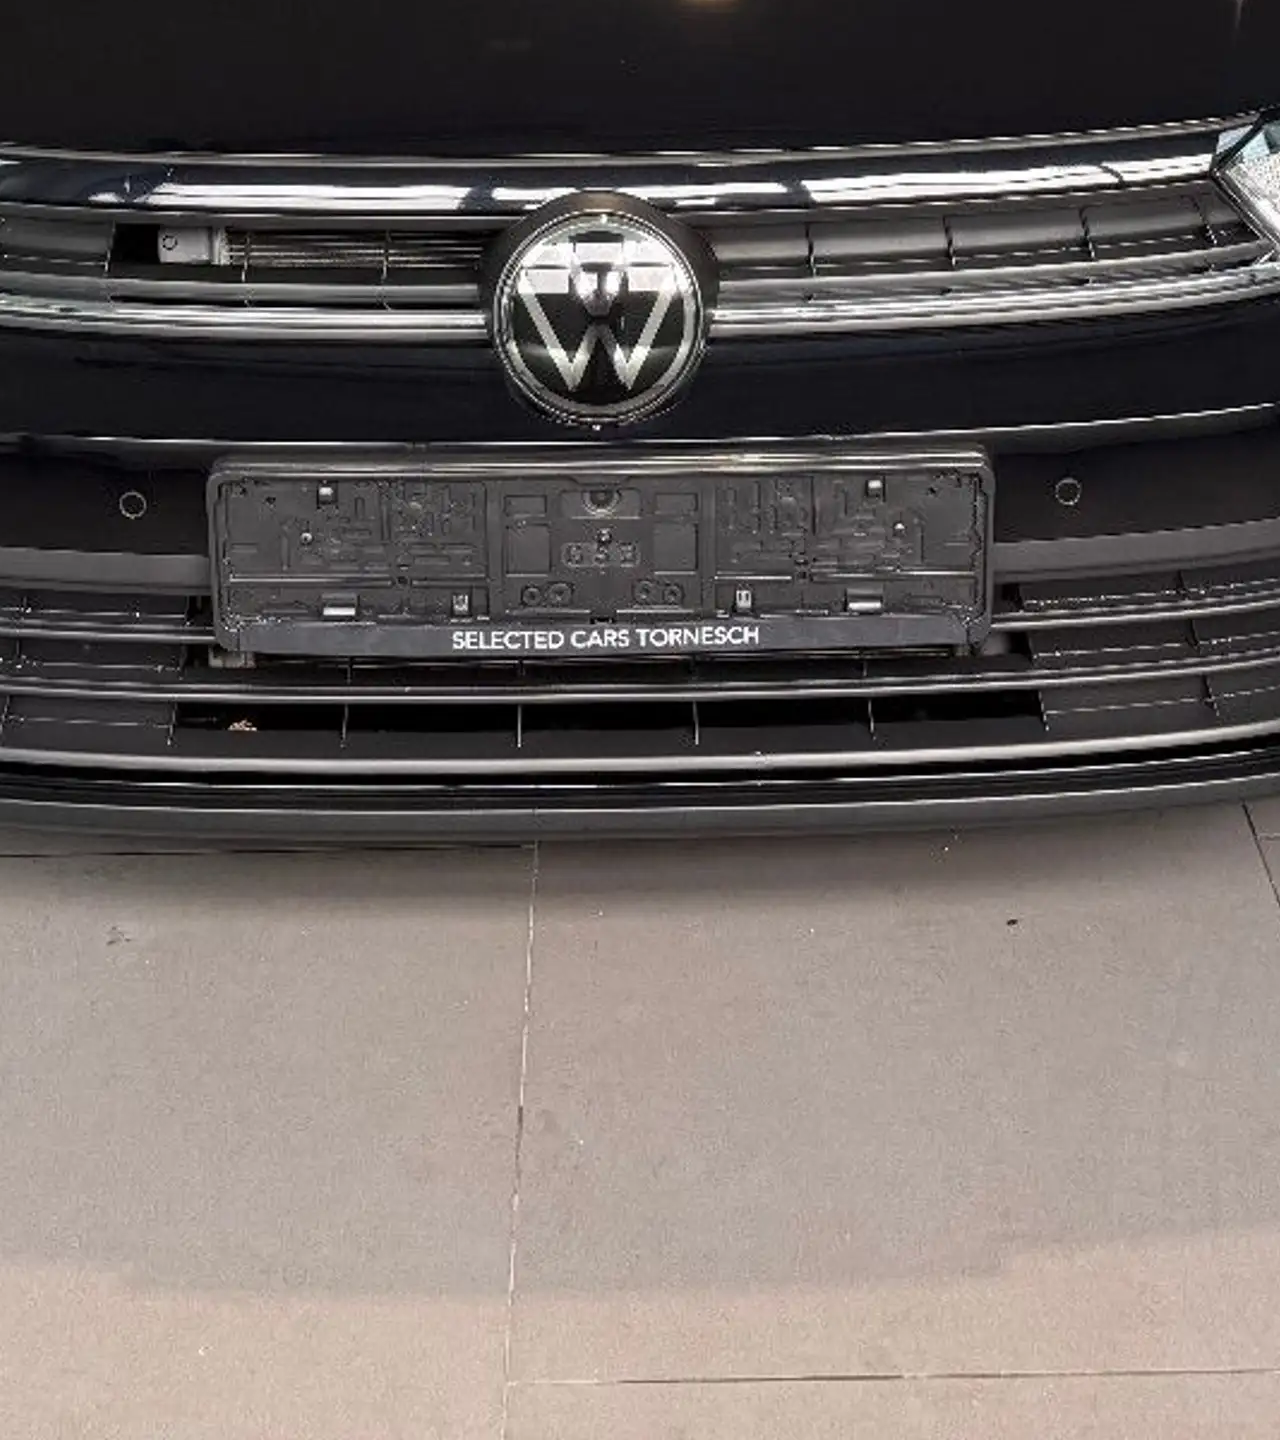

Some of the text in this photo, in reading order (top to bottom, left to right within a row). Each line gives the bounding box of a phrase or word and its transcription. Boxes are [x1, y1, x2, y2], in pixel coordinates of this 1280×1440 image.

[452, 626, 760, 650] SELECTED CARS TORNESCH
